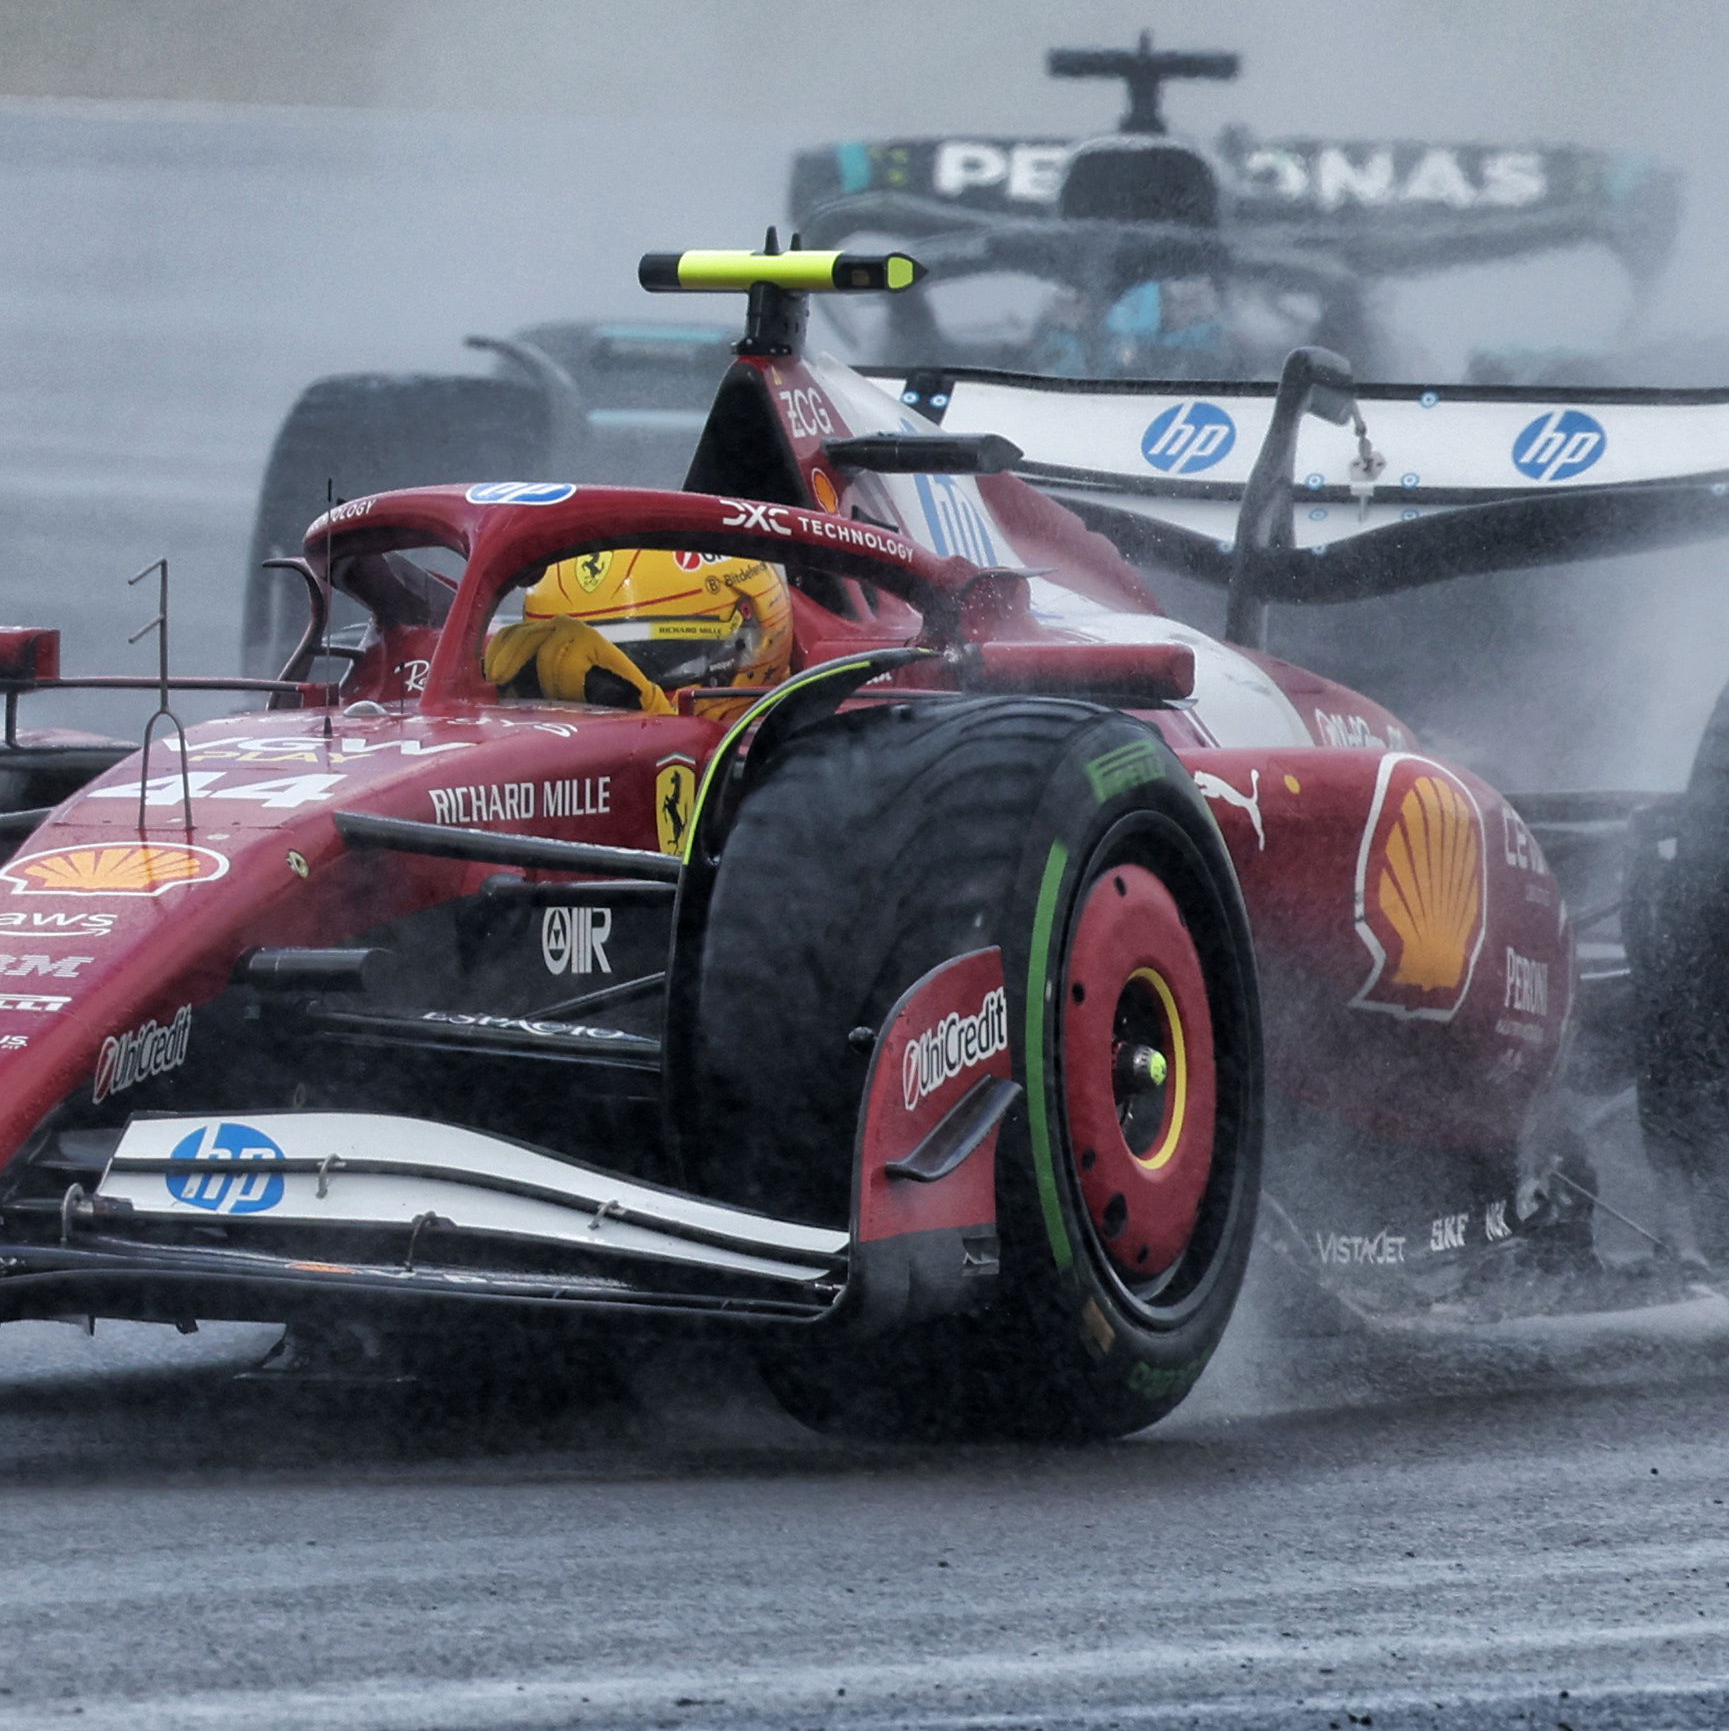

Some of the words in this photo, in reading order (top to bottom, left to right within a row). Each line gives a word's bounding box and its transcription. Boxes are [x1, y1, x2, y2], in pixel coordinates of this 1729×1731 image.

[932, 145, 1549, 208] PEONAS
[1146, 401, 1233, 473] hp
[1517, 410, 1603, 481] hp
[798, 516, 914, 563] TECHNOLOGY
[189, 751, 373, 764] PLAY
[87, 771, 349, 809] 44
[429, 783, 535, 825] RICHARD
[543, 776, 612, 819] MILLE
[919, 986, 1009, 1094] UniCredit
[176, 1122, 279, 1214] hp
[1430, 1212, 1469, 1253] SKF
